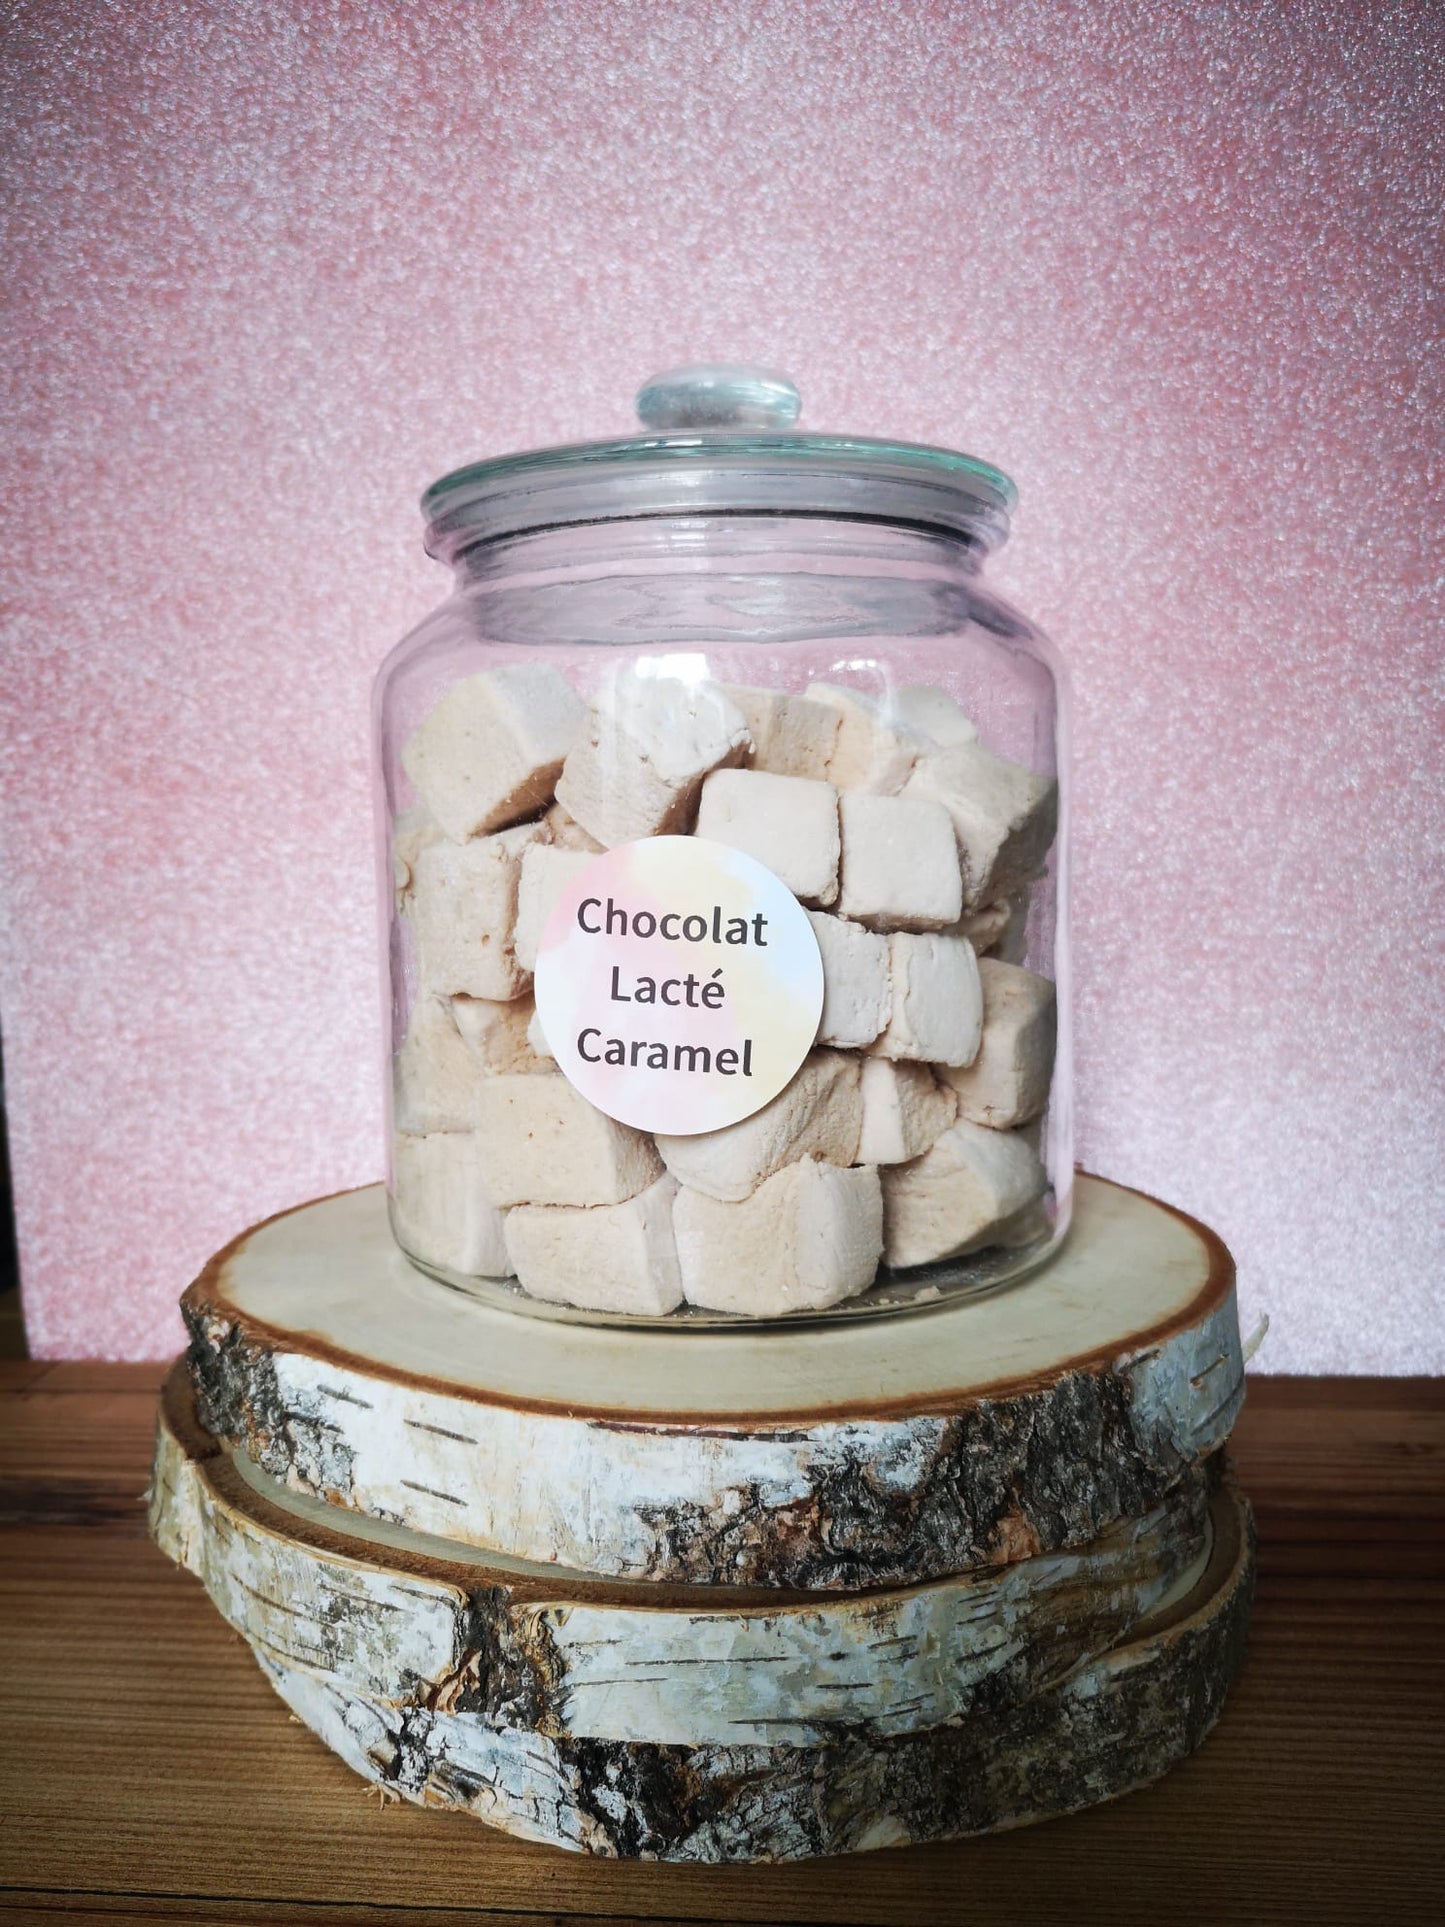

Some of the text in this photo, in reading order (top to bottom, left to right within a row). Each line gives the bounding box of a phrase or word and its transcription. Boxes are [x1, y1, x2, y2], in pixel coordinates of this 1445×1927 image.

[577, 897, 769, 947] Chocolat
[610, 965, 726, 1010] Lacté
[577, 1028, 753, 1077] Caramel
